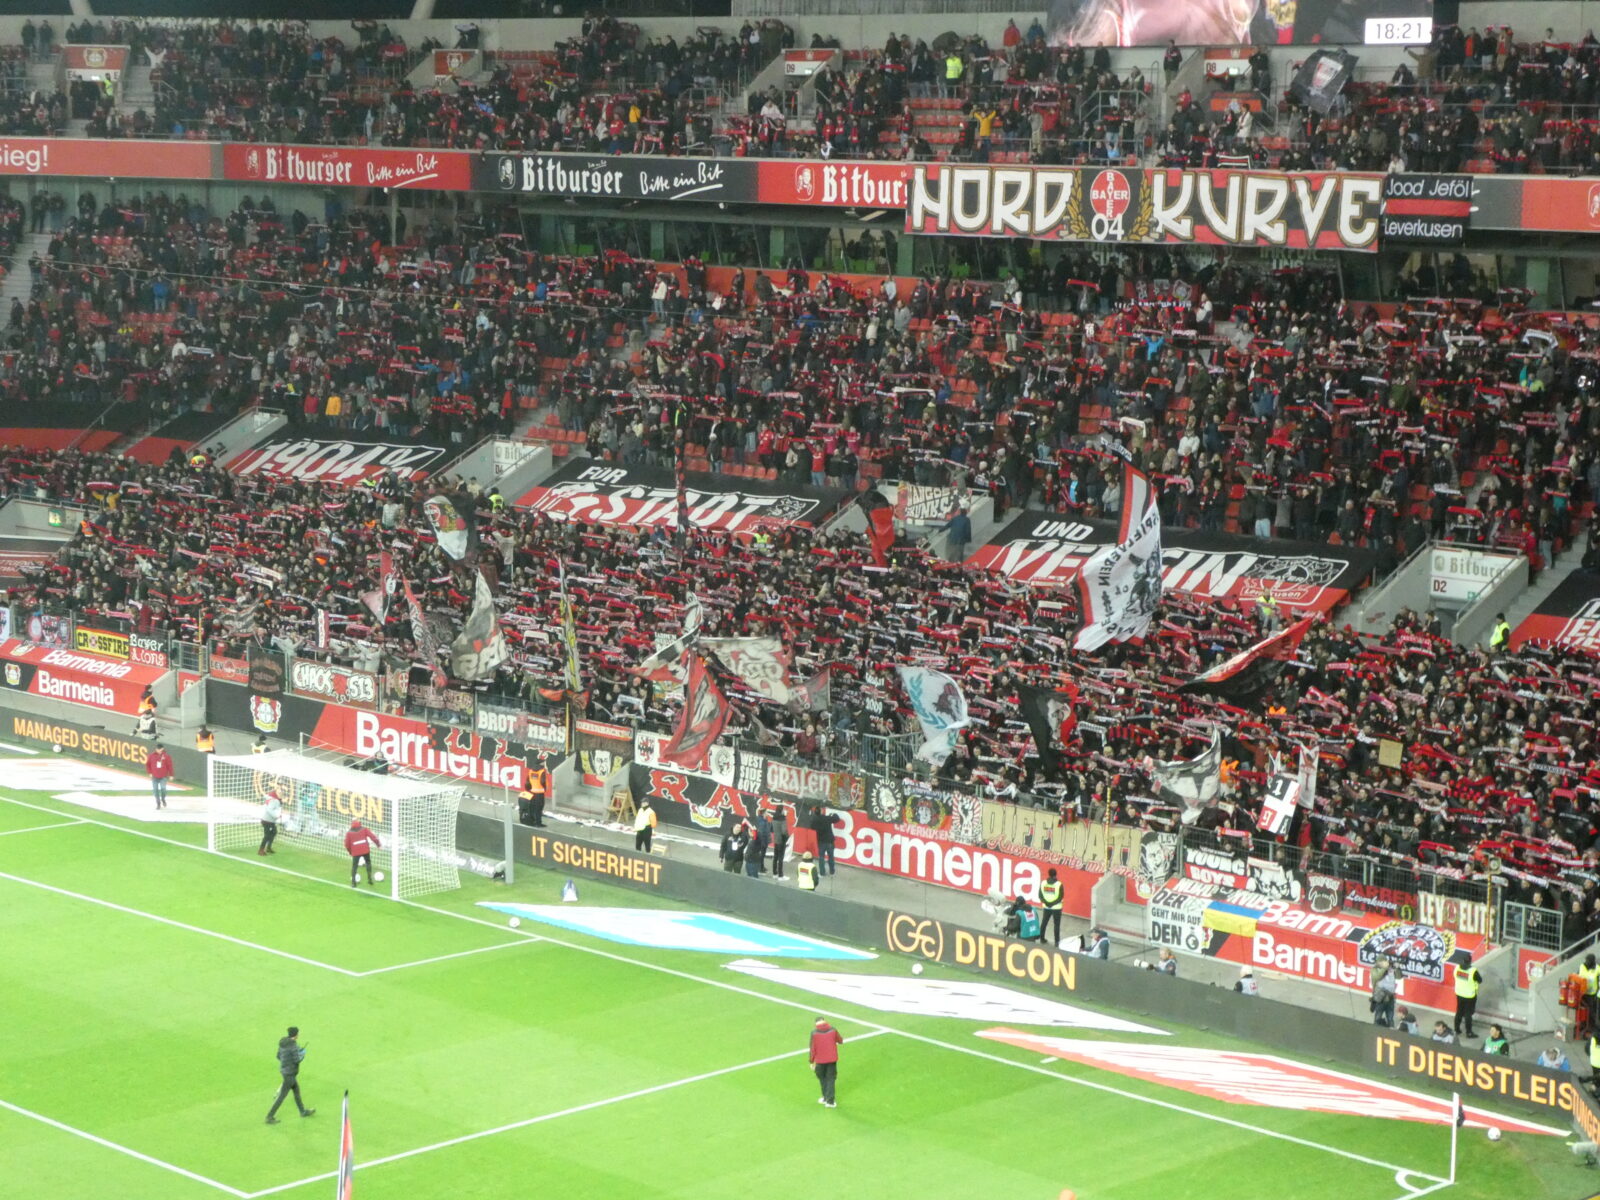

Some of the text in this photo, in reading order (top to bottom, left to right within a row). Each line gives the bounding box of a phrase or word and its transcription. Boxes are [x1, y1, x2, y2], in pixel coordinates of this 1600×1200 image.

[1376, 23, 1422, 39] 18:21
[0, 144, 48, 172] ieg!
[266, 147, 352, 182] Bitburger
[367, 153, 438, 183] Bitte ein Bit
[521, 157, 623, 194] Bitburger
[640, 161, 723, 194] Bitte ein Bit
[822, 165, 907, 205] Bitbur
[1386, 179, 1425, 196] Jood
[912, 168, 1074, 232] NORD
[1092, 190, 1128, 199] BAYER
[1153, 171, 1383, 247] KURVE
[1092, 213, 1125, 240] 04
[1385, 219, 1463, 238] Leverkusen
[577, 466, 628, 483] FÜR
[1032, 520, 1094, 541] UND
[1000, 540, 1258, 597] VEIN
[1433, 580, 1447, 593] D2
[130, 633, 164, 652] Bayer
[40, 649, 133, 678] Barmenia
[38, 670, 115, 706] Barmenia
[478, 711, 516, 733] BROT
[14, 718, 148, 765] MANAGED SERVICES
[740, 753, 764, 768] WEST
[740, 766, 763, 781] SIDE
[738, 780, 762, 795] BOYZ
[315, 784, 384, 824] ITCON
[531, 835, 662, 885] IT SICHERHEIT
[825, 807, 1041, 903] Barmenia
[1186, 848, 1245, 876] YOUNG
[1190, 865, 1236, 888] BOYS
[1152, 888, 1188, 908] DER
[1418, 891, 1444, 927] LEV
[1151, 907, 1169, 919] GEHT
[1171, 911, 1186, 923] MIR
[1151, 920, 1183, 946] DEN
[955, 930, 1076, 990] DITCON
[1376, 1037, 1401, 1066] IT
